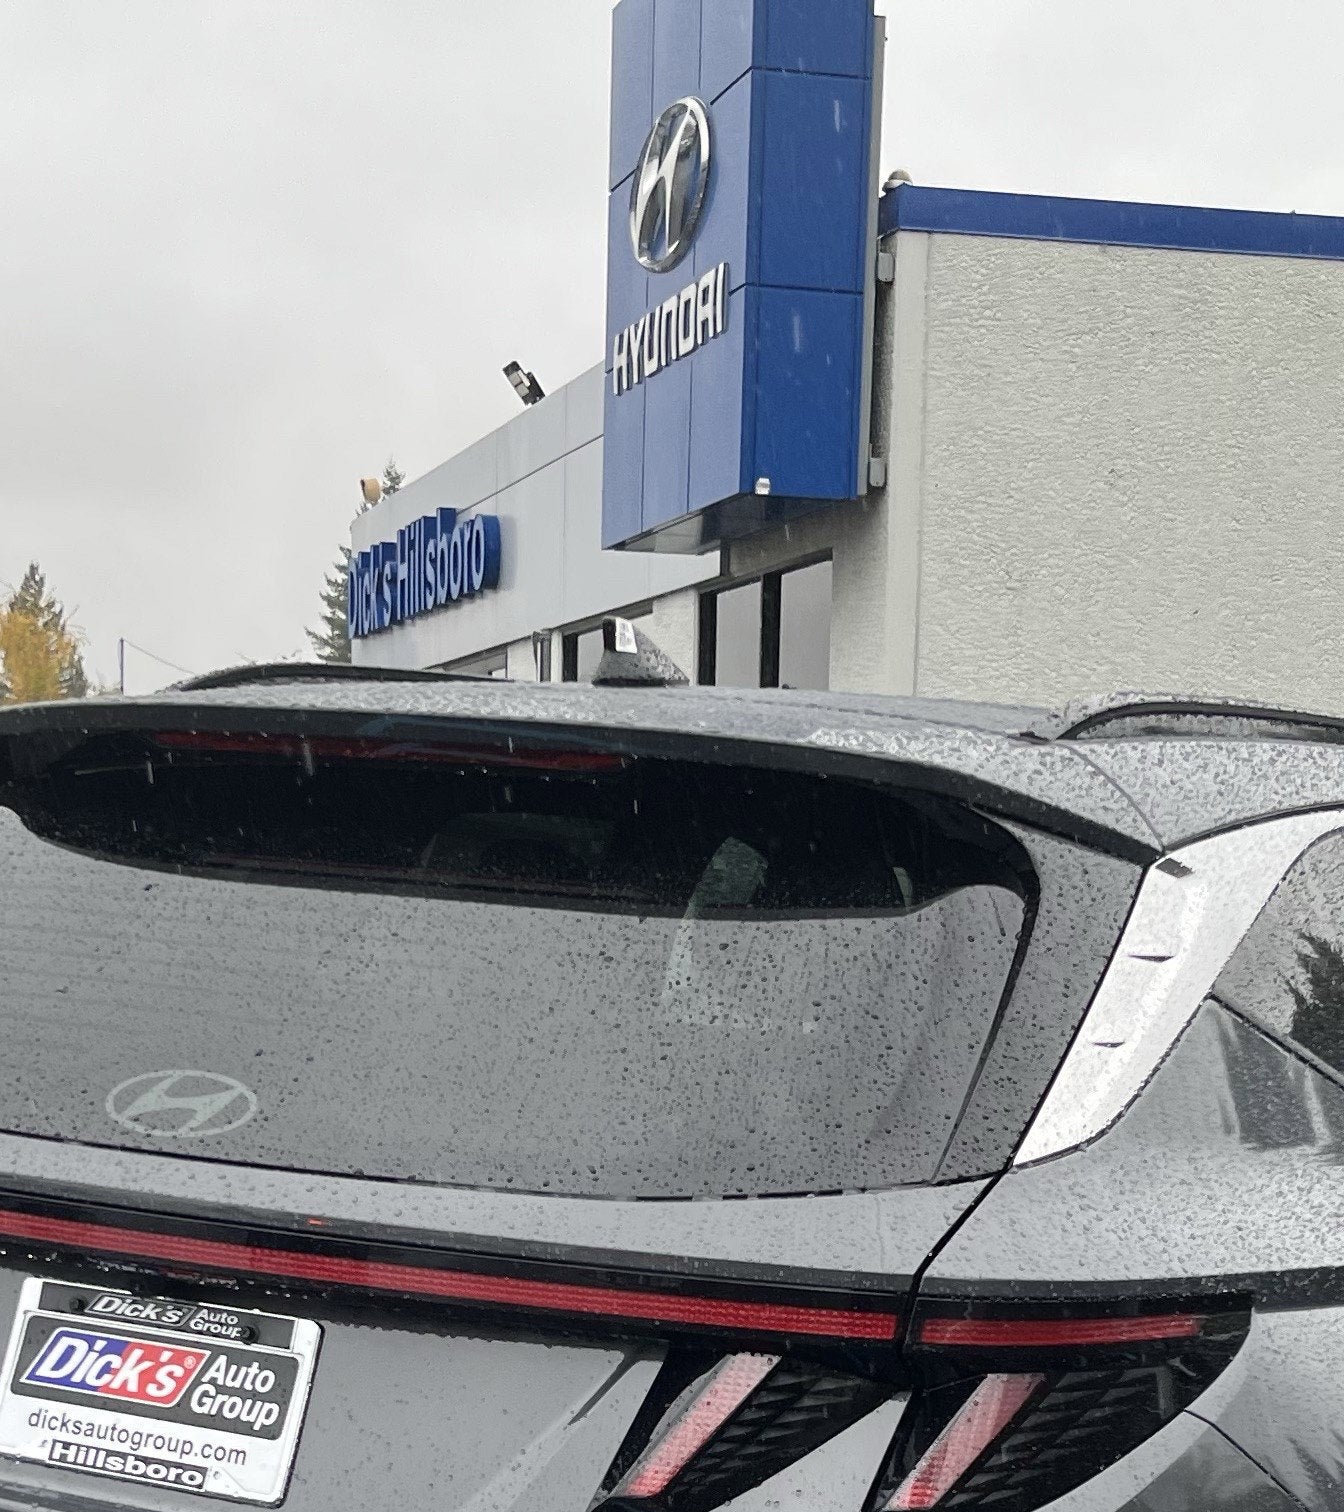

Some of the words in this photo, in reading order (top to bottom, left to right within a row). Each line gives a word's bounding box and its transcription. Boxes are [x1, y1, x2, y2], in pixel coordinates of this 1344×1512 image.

[613, 262, 725, 395] HYUNDAI
[348, 541, 392, 639] Dick's
[397, 507, 485, 620] Hillsboro
[93, 1295, 184, 1325] Dick's
[189, 1317, 244, 1339] Group
[193, 1308, 239, 1326] Auto
[34, 1335, 186, 1398] Dick's
[201, 1354, 276, 1393] Auto
[190, 1384, 280, 1431] Group
[28, 1408, 248, 1466] dicksautogroup.com
[52, 1440, 205, 1487] Hillsboro
